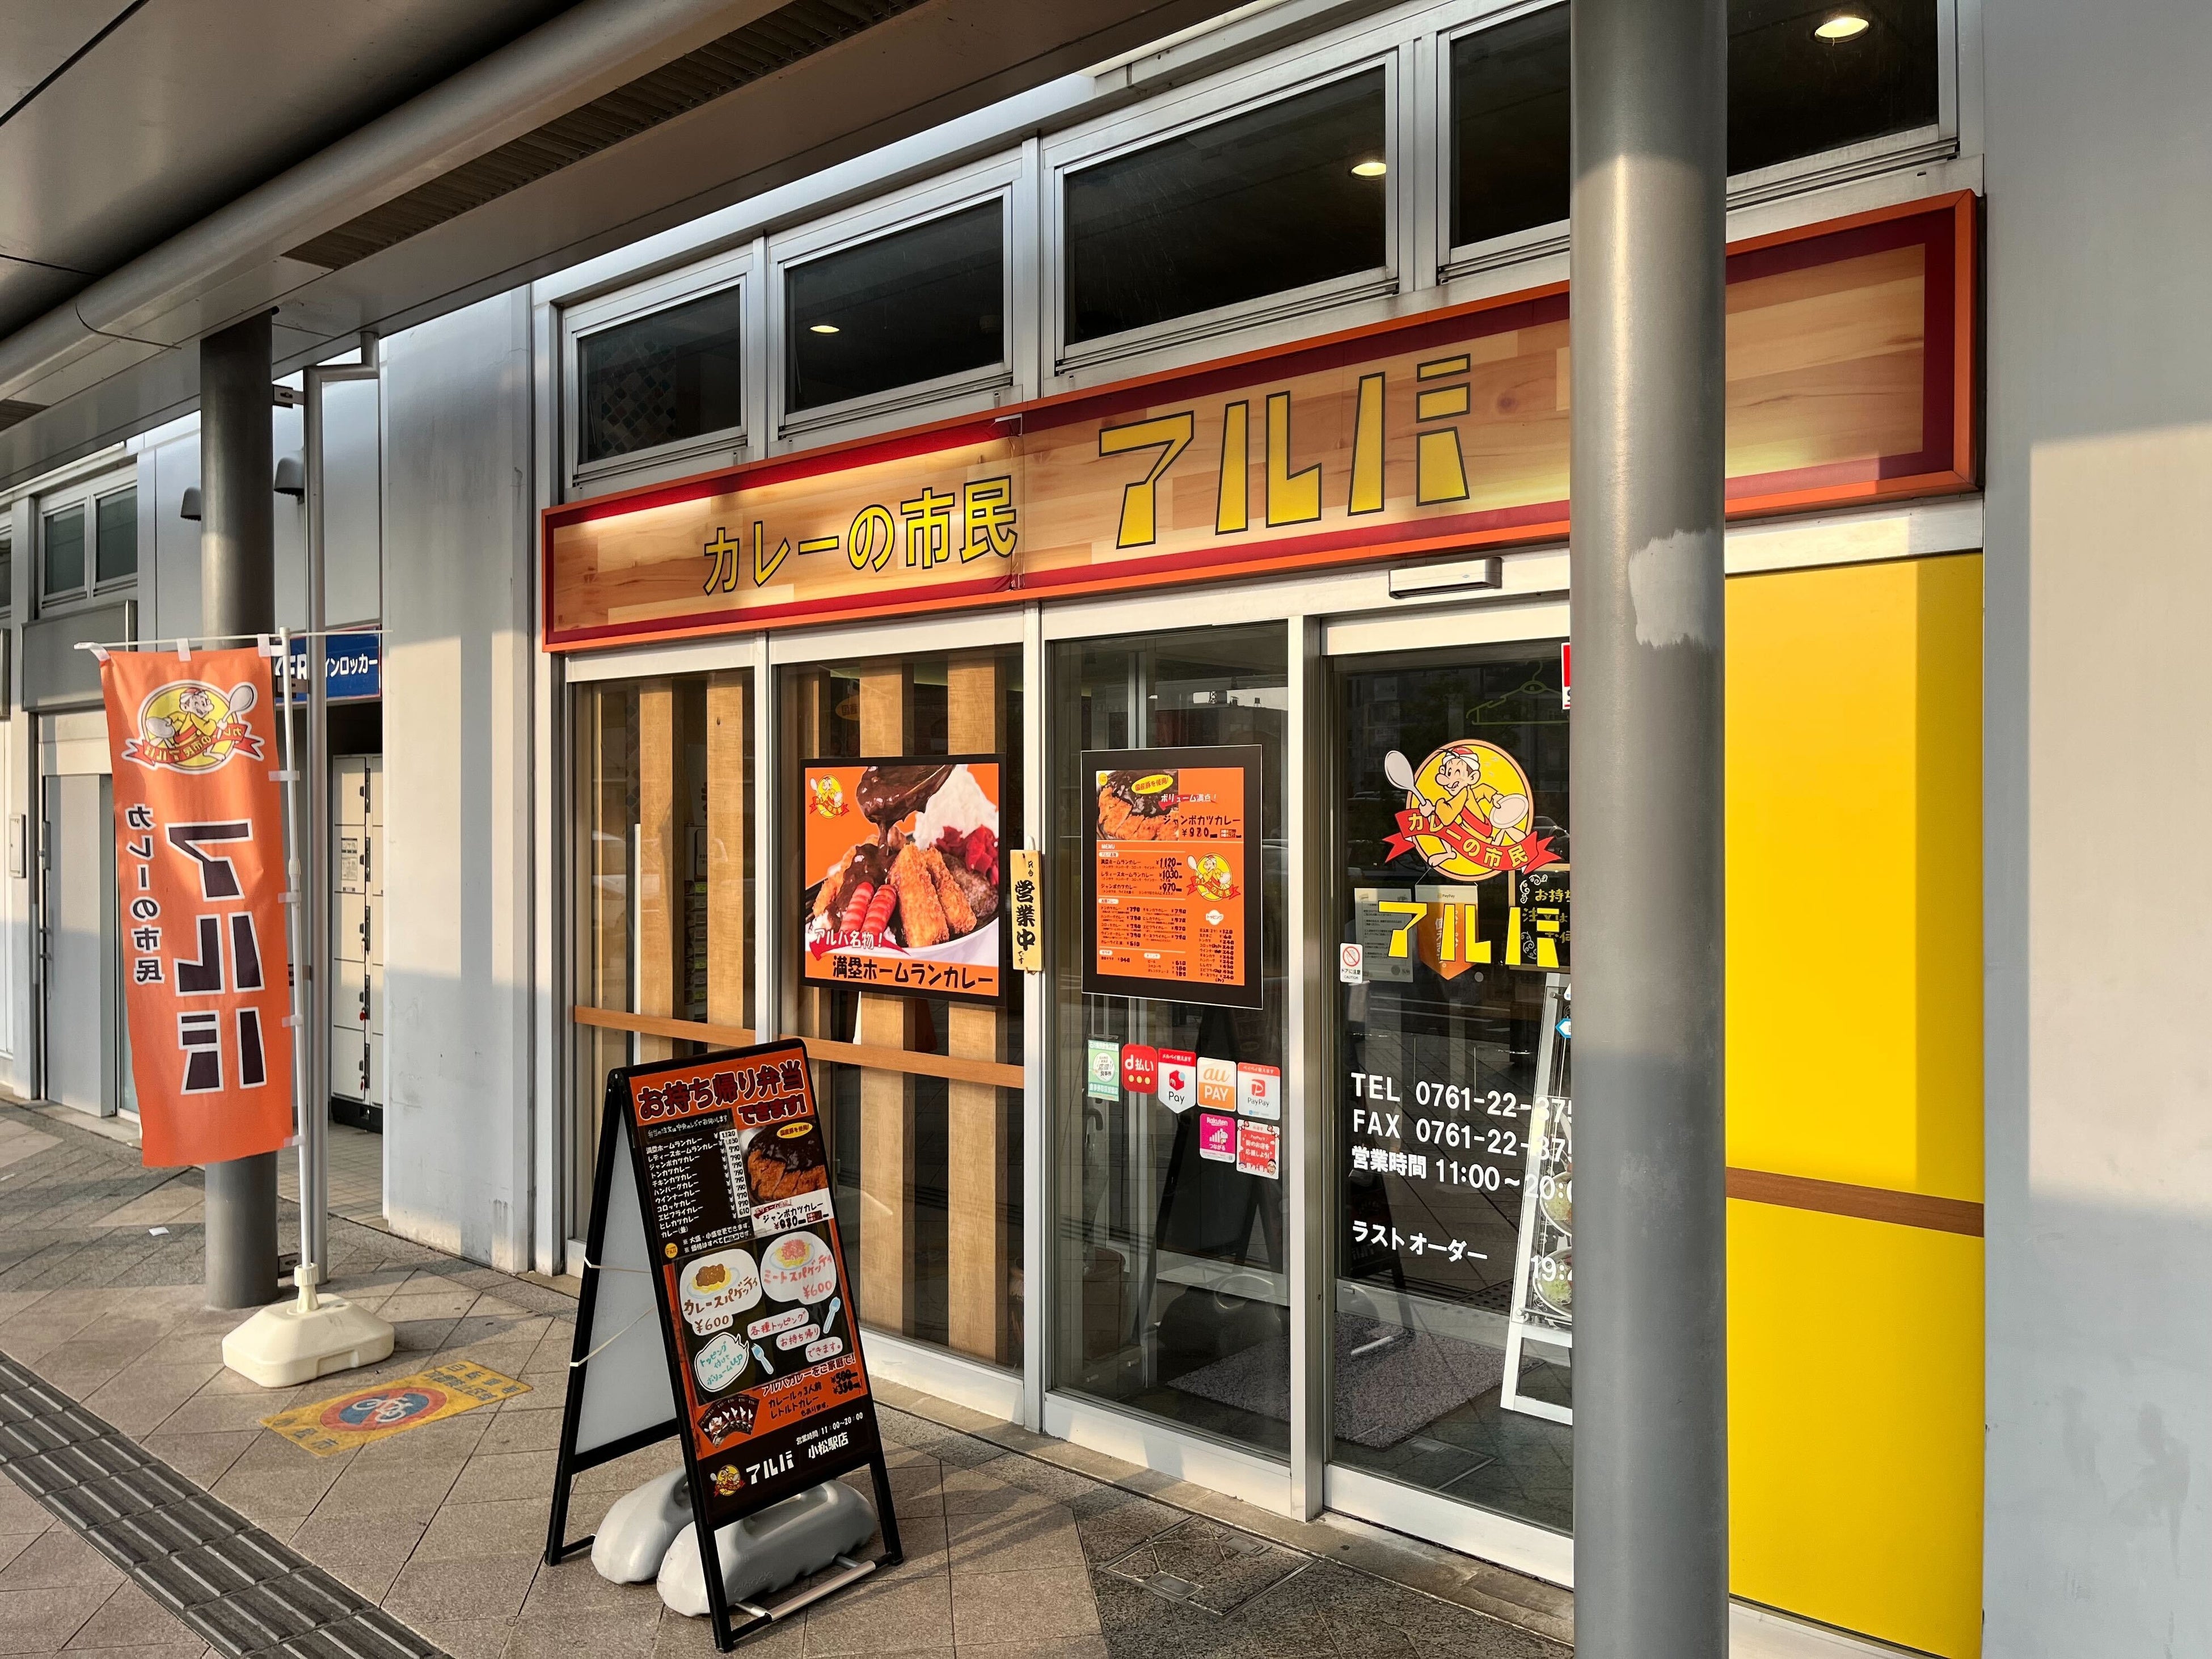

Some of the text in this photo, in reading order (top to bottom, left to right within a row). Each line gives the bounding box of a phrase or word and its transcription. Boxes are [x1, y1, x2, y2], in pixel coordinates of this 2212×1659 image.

[1099, 353, 1470, 550] アルバ
[703, 475, 1019, 595] カレーの市民
[1408, 813, 1529, 868] カレーの市民
[1015, 880, 1036, 951] 営業中
[1378, 900, 1560, 969] アルバ
[833, 956, 993, 989] 満塁ホームランカレー
[1125, 1054, 1154, 1071] d払い
[1204, 1069, 1230, 1082] au
[637, 1060, 804, 1120] お持ち帰り弁当
[1169, 1091, 1184, 1104] Pay
[1205, 1085, 1229, 1101] PAY
[1351, 1073, 1401, 1102] TEL
[1248, 1097, 1269, 1107] PayPay
[1206, 1117, 1228, 1125] Rakuten
[1353, 1109, 1400, 1139] FAX
[650, 1164, 691, 1179] トンカツカレー
[1352, 1145, 1426, 1180] 営業時間
[652, 1171, 698, 1187] チキンカツカレー
[1531, 1255, 1572, 1282] 19:
[803, 1281, 833, 1299] ¥600
[695, 1315, 729, 1333] ¥600
[780, 1327, 819, 1347] お持ち帰り
[807, 1431, 850, 1459] 小松駅店
[745, 1450, 795, 1486] アルバ
